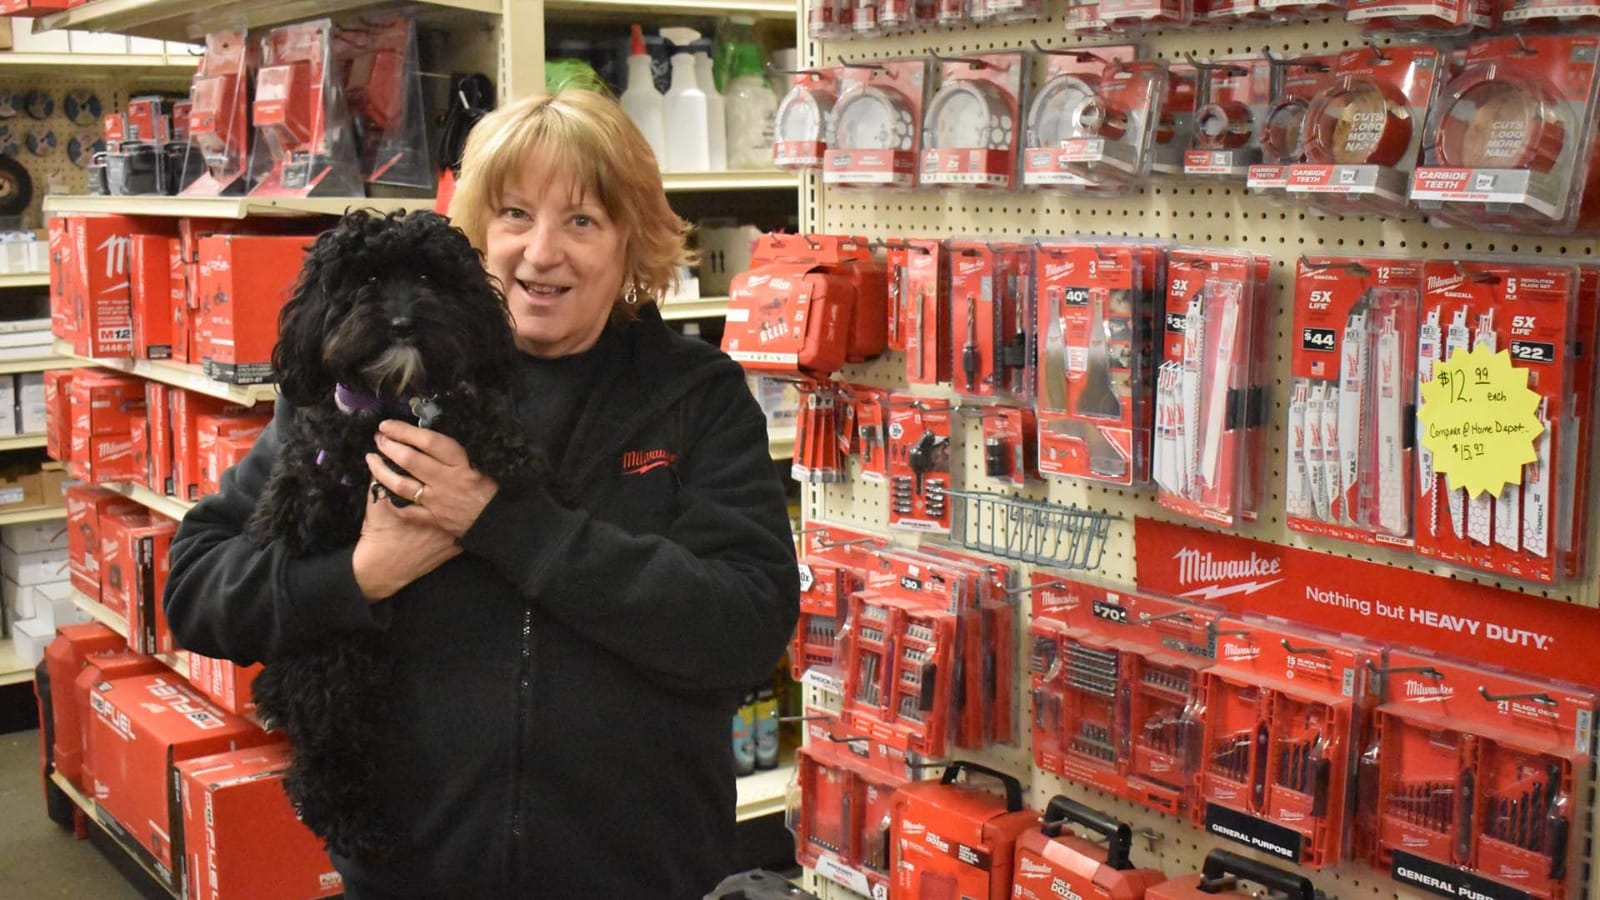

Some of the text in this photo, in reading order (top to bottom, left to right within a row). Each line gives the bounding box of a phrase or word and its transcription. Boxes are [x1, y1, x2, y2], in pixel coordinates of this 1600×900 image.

[1419, 171, 1467, 180] CARBIDE
[1424, 180, 1459, 189] TEETH
[1377, 266, 1390, 279] 12
[1171, 279, 1188, 291] 3X
[1507, 277, 1517, 294] 5
[1309, 290, 1333, 303] 5X
[1308, 302, 1329, 310] LIFE
[1511, 315, 1536, 328] 5X
[100, 329, 131, 340] M12
[1304, 331, 1334, 346] $44
[1511, 328, 1532, 336] LIFE
[1512, 344, 1545, 359] $22
[1487, 391, 1507, 402] each
[1471, 423, 1494, 434] Home
[1172, 546, 1282, 586] Milwaukee
[1305, 585, 1371, 616] Nothing
[1376, 600, 1405, 620] but
[1409, 607, 1480, 636] HEAVY
[1404, 679, 1454, 697] Milwaukee
[1496, 699, 1509, 711] 21
[1212, 824, 1293, 858] GENERAL PURPOSE
[1053, 876, 1072, 890] HOLE
[1396, 867, 1456, 894] GENERAL
